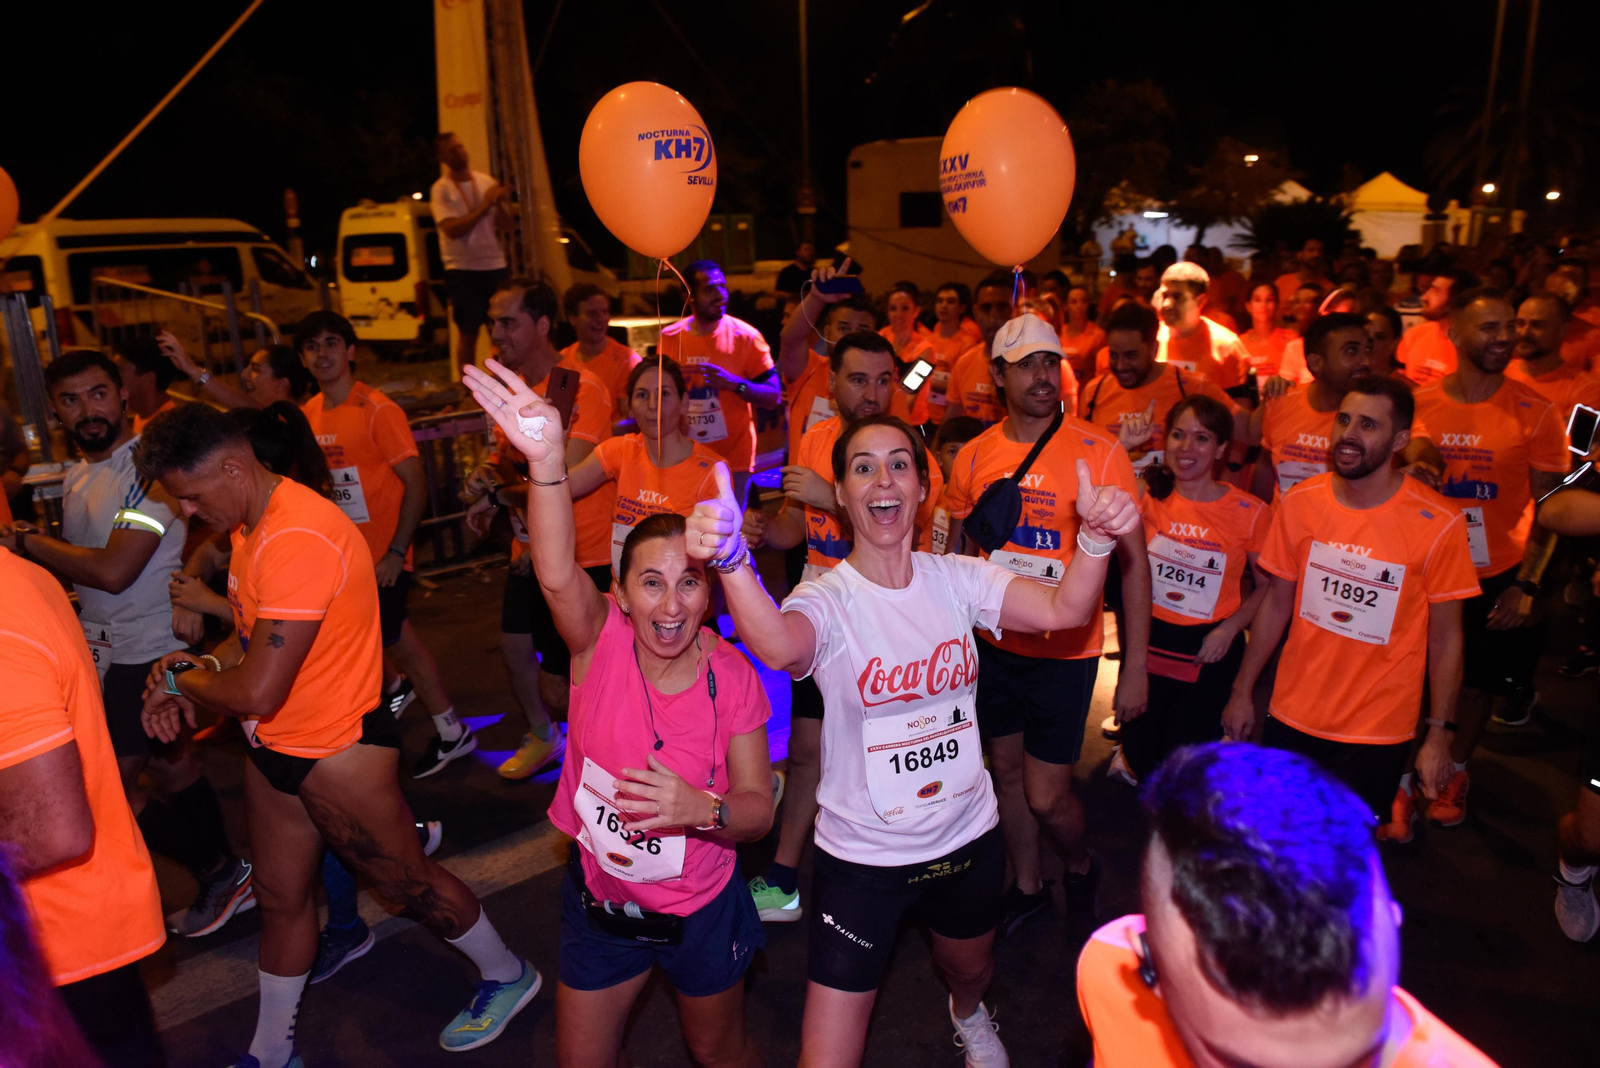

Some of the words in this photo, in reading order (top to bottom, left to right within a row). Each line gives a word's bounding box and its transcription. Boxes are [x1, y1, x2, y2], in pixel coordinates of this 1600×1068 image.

[638, 129, 691, 141] NOCTURNA
[687, 175, 714, 186] SEVILLA
[687, 414, 716, 425] 21730
[1440, 433, 1482, 446] XXXV
[619, 495, 646, 509] CARRERA
[637, 489, 669, 504] XXXV
[1168, 522, 1209, 538] XXXV
[1156, 562, 1206, 589] 12614
[1321, 576, 1379, 608] 11892
[92, 648, 100, 663] 5
[857, 633, 978, 708] Coca-Cola
[889, 738, 960, 775] 16849
[596, 805, 662, 856] 16526
[834, 924, 874, 950] RAIDLIGHT
